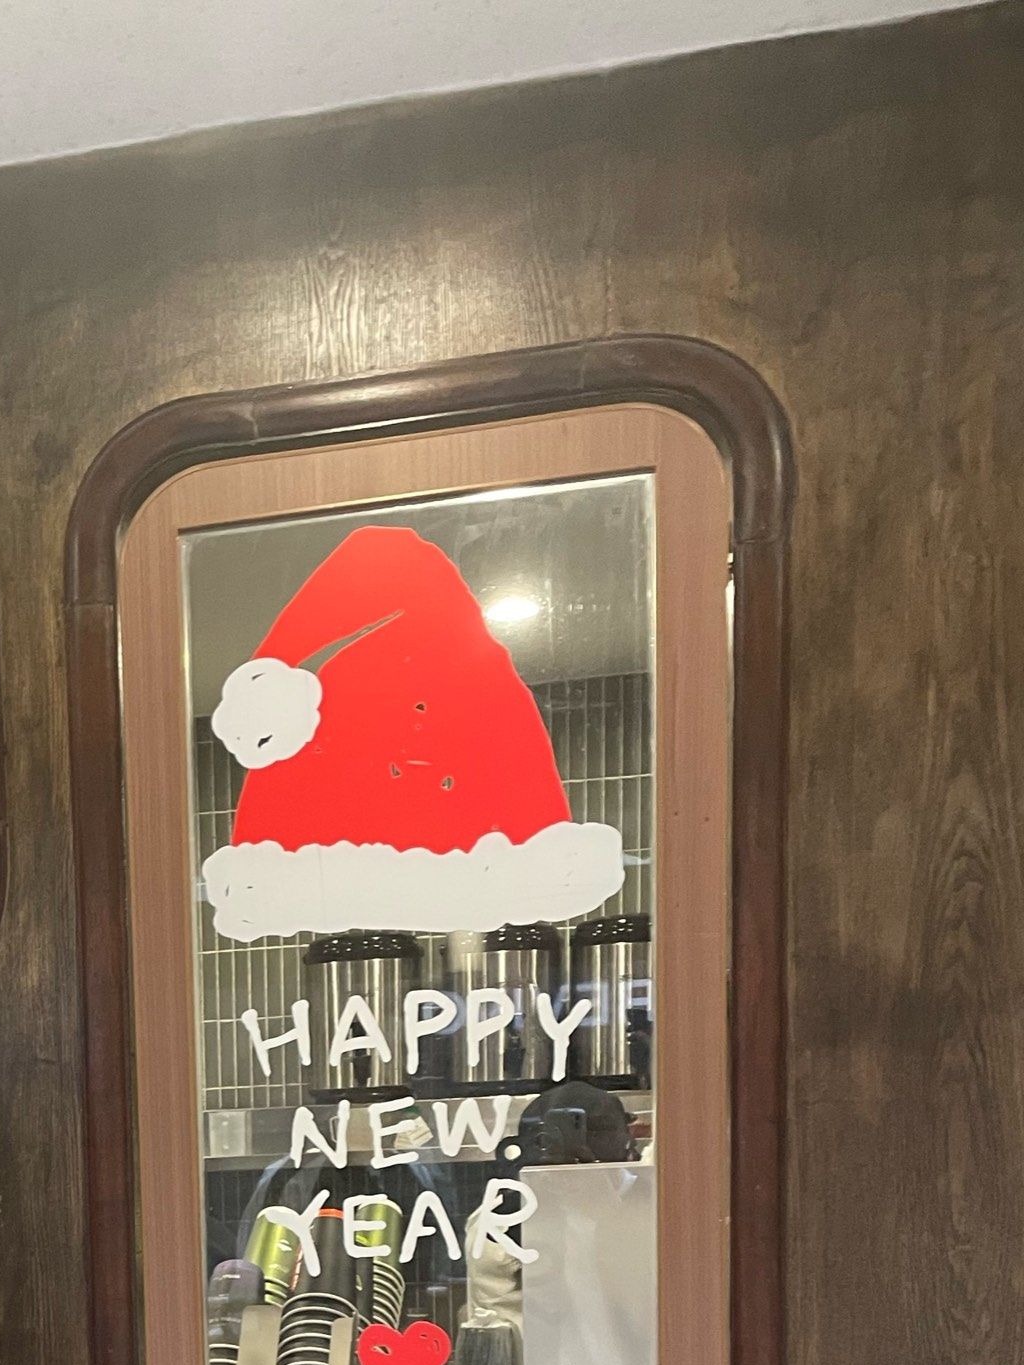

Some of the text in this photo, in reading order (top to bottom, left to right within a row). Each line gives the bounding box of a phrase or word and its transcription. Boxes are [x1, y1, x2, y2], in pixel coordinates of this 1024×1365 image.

[241, 988, 592, 1082] HAPPY
[290, 1094, 512, 1169] NEW
[264, 1178, 539, 1277] YEAR
